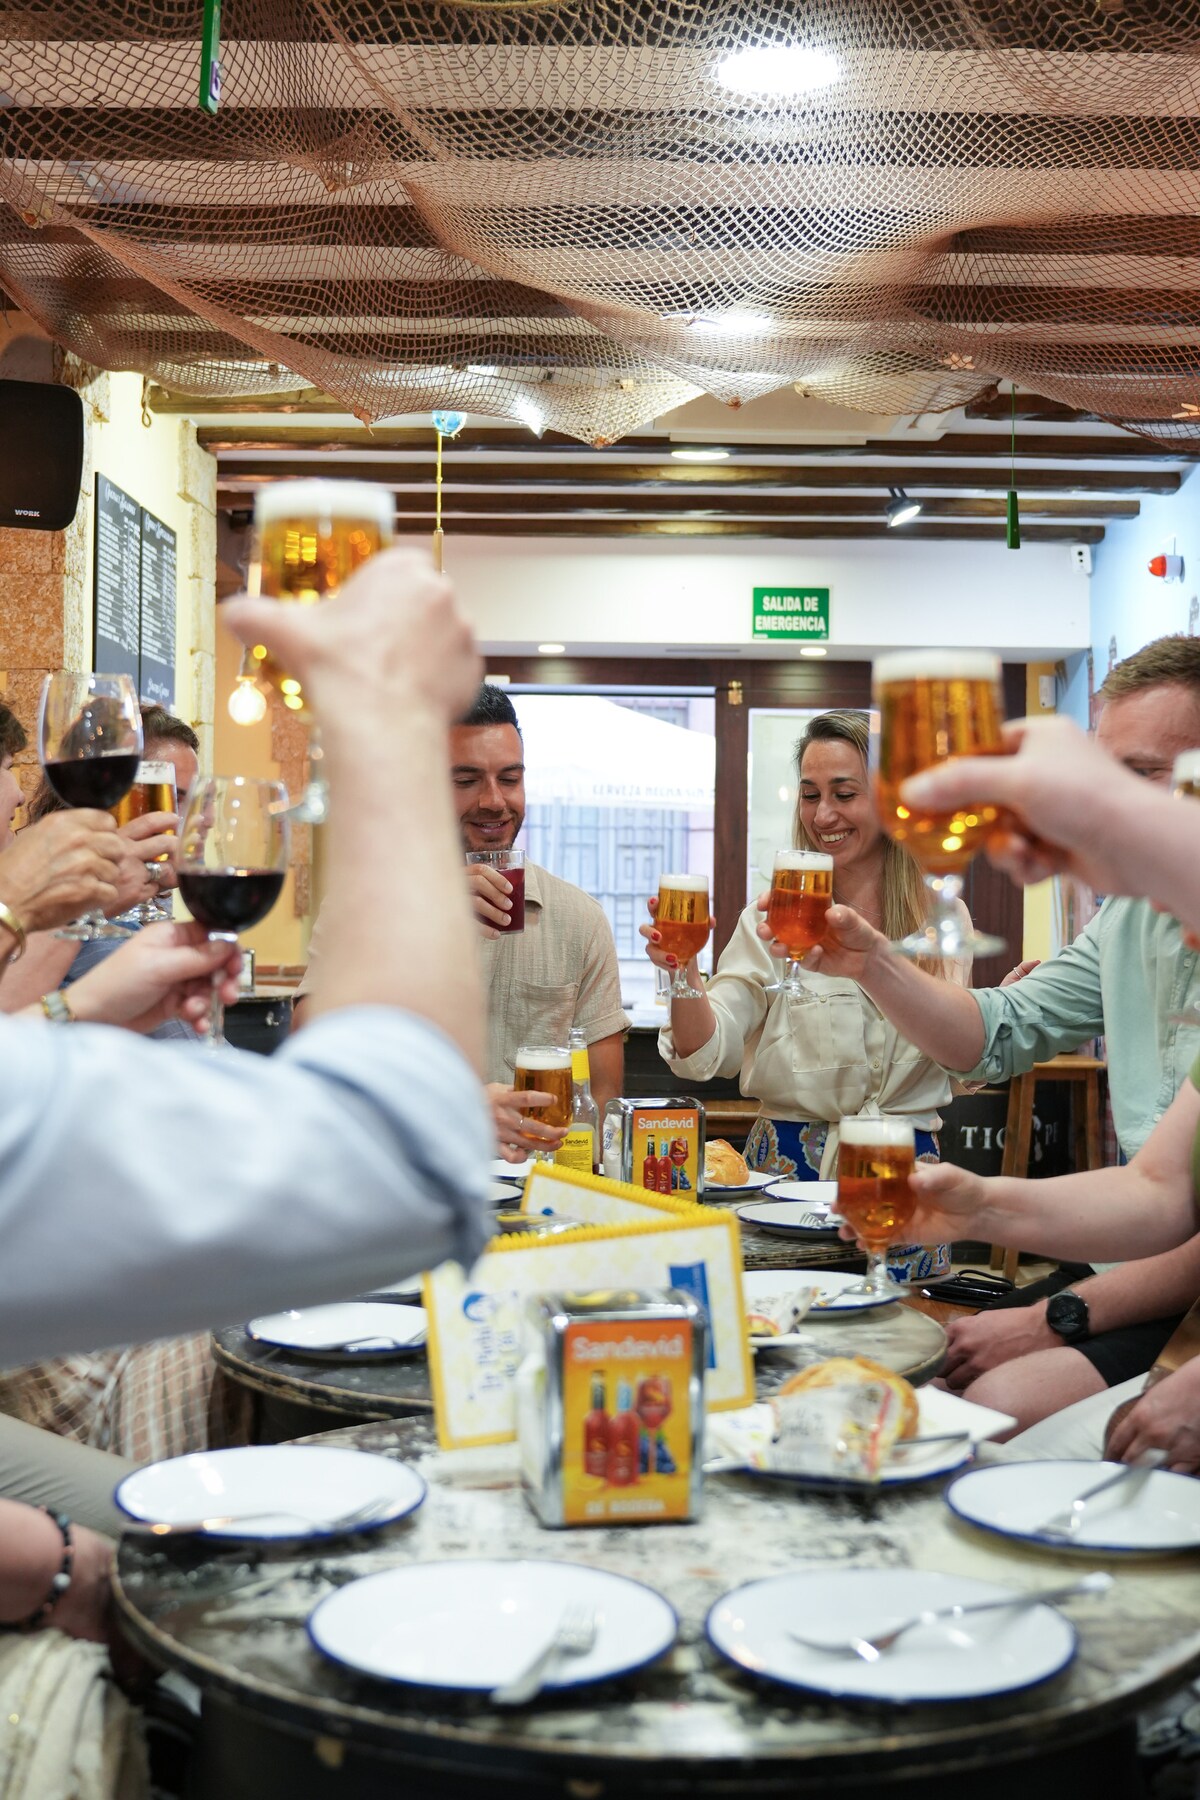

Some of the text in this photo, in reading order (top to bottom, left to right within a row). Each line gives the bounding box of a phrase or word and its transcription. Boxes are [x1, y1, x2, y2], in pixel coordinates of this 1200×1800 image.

[14, 509, 40, 517] WORK
[762, 595, 819, 612] SALIDA DE
[755, 615, 826, 631] EMERGENCIA
[638, 1117, 694, 1129] Sandevid
[572, 1336, 684, 1361] Sandevid
